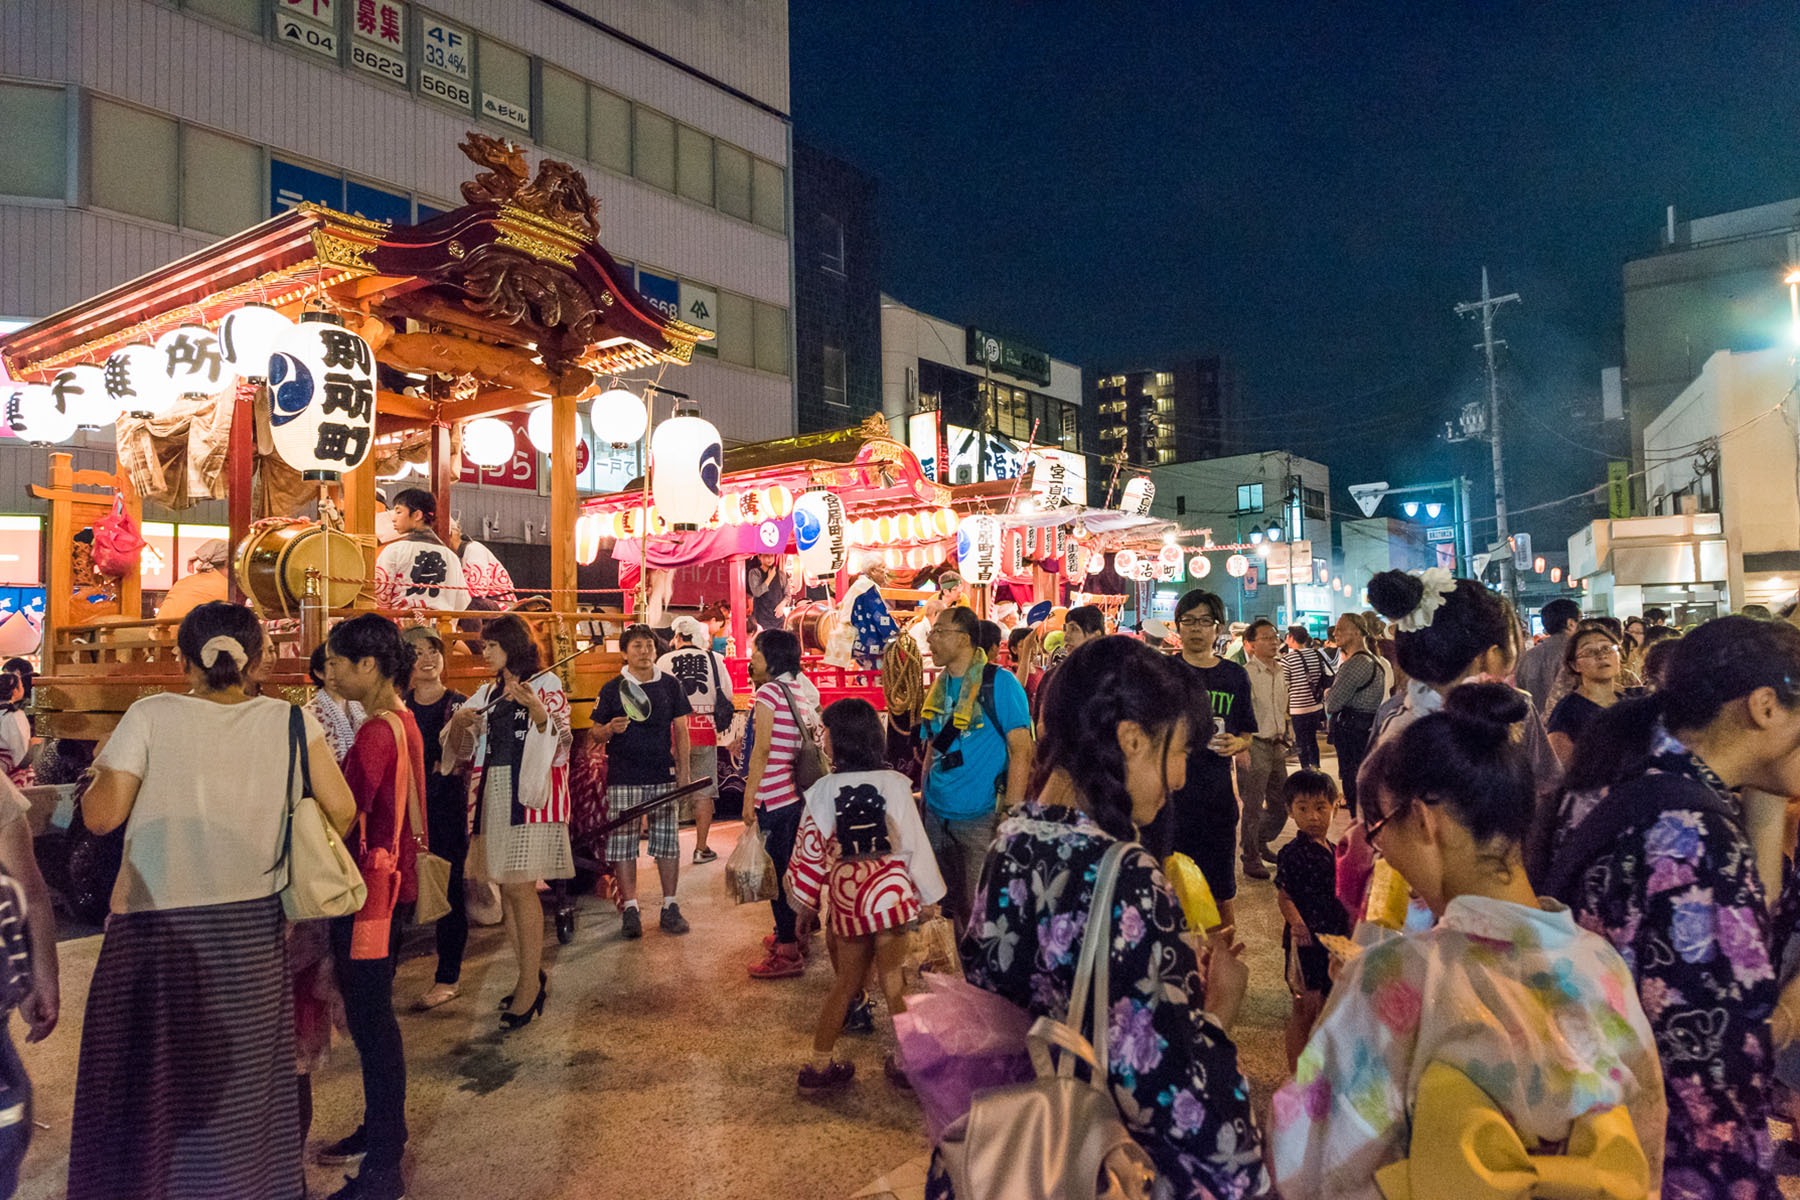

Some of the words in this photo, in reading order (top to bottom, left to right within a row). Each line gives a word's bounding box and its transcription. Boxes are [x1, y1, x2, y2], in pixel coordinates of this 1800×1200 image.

[356, 0, 401, 45] 募集
[428, 26, 463, 48] 4F
[306, 30, 334, 51] 04
[352, 47, 404, 79] 8623
[422, 75, 470, 106] 5668
[497, 104, 527, 125] 杉ビル
[314, 329, 374, 467] 別所町
